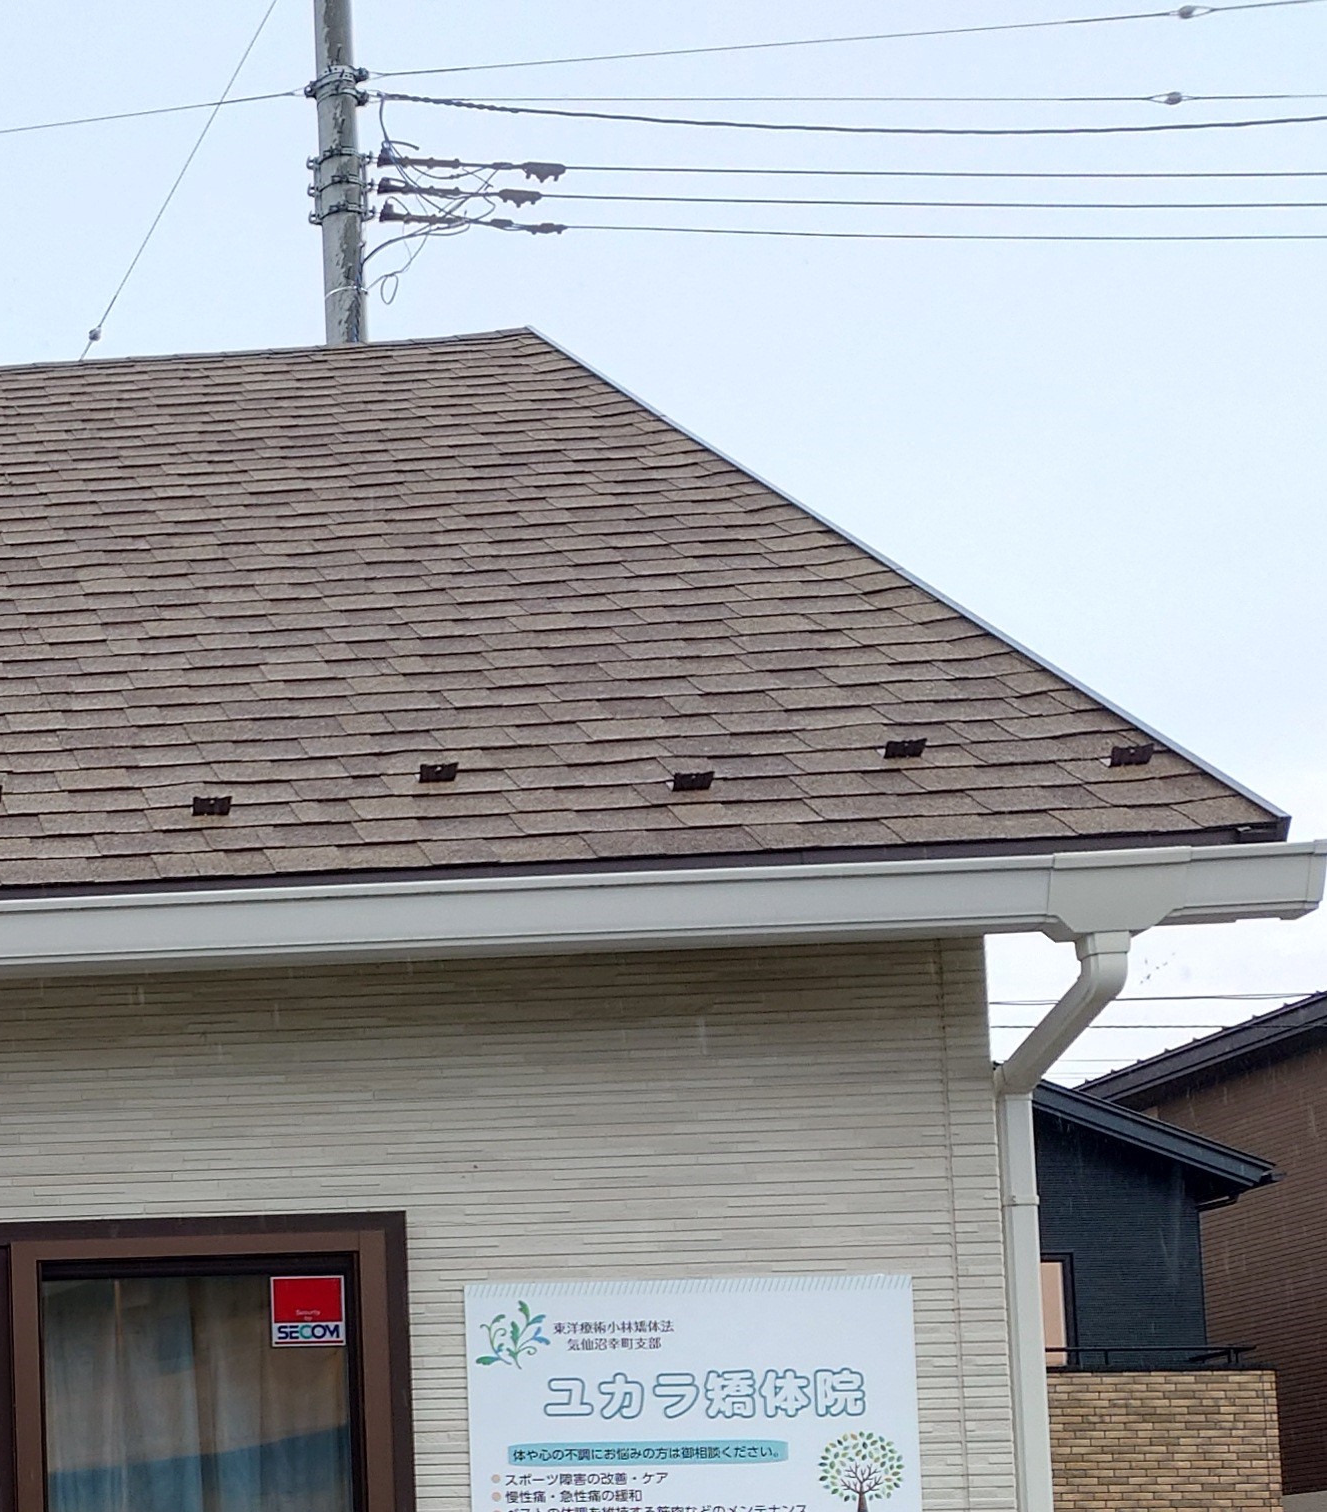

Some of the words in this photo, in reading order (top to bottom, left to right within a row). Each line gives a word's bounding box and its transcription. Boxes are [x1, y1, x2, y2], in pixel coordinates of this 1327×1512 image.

[277, 1324, 340, 1340] SECOM
[567, 1337, 662, 1351] 気仙沼幸町支部
[544, 1368, 866, 1419] ユカラ矯体院
